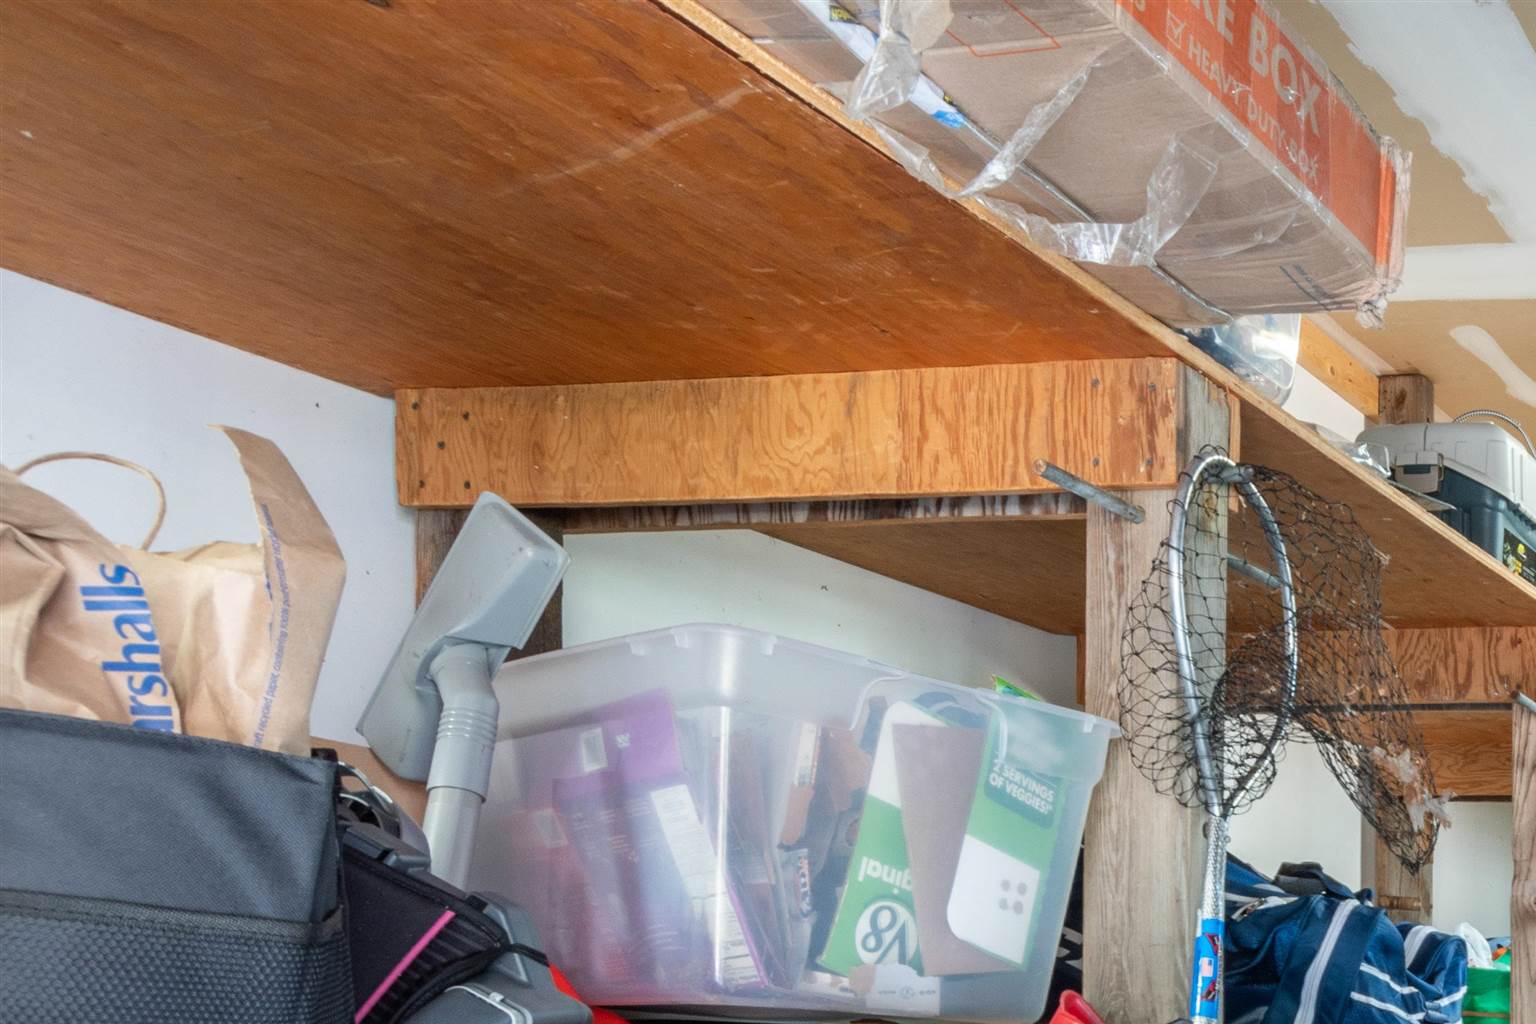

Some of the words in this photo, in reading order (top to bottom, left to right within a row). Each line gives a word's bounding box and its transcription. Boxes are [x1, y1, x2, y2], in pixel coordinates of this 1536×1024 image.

[1186, 33, 1245, 107] HEAVY
[1247, 93, 1286, 150] DUTY
[1249, 13, 1321, 139] BOX
[988, 772, 1005, 789] OF
[1001, 767, 1057, 803] SERVINGS
[860, 904, 911, 966] V8
